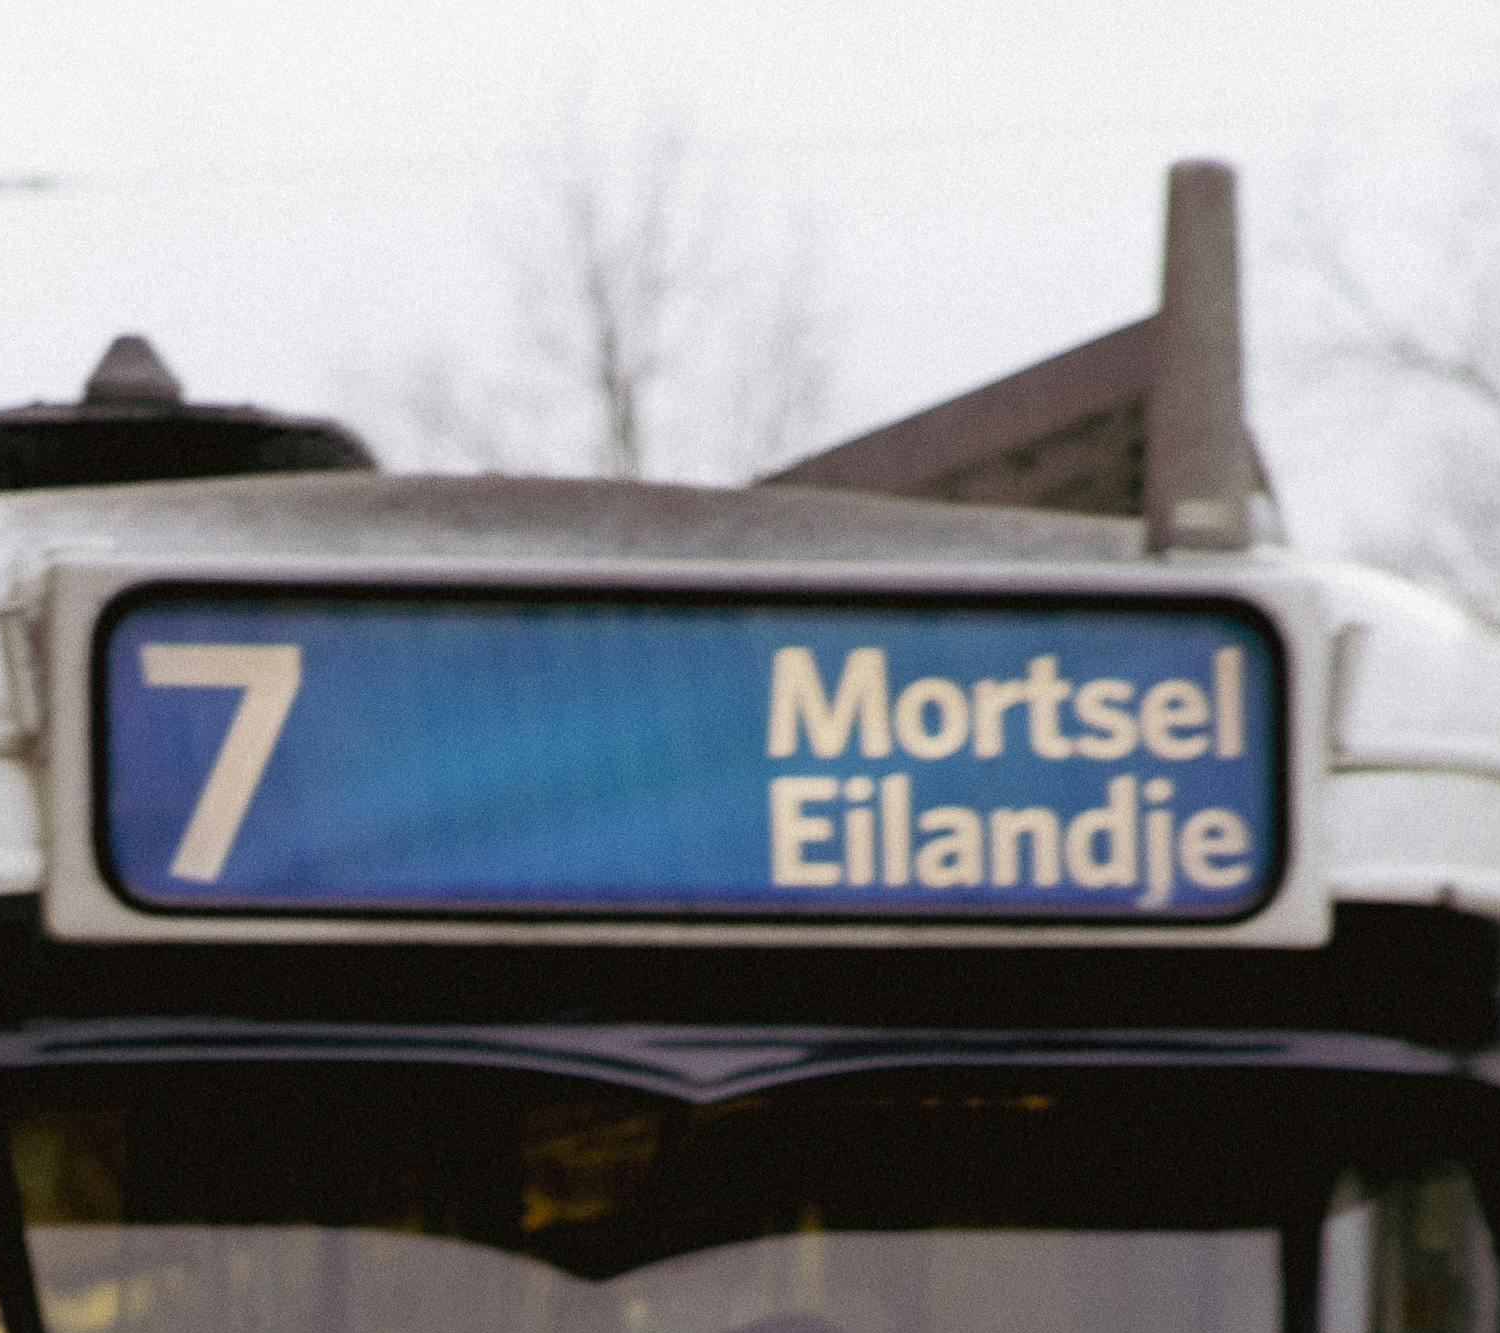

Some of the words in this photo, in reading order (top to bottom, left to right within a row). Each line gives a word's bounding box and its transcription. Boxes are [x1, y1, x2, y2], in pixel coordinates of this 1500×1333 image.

[140, 643, 303, 882] 7
[768, 646, 1246, 761] Mortsel
[768, 774, 1251, 910] Eilandje
